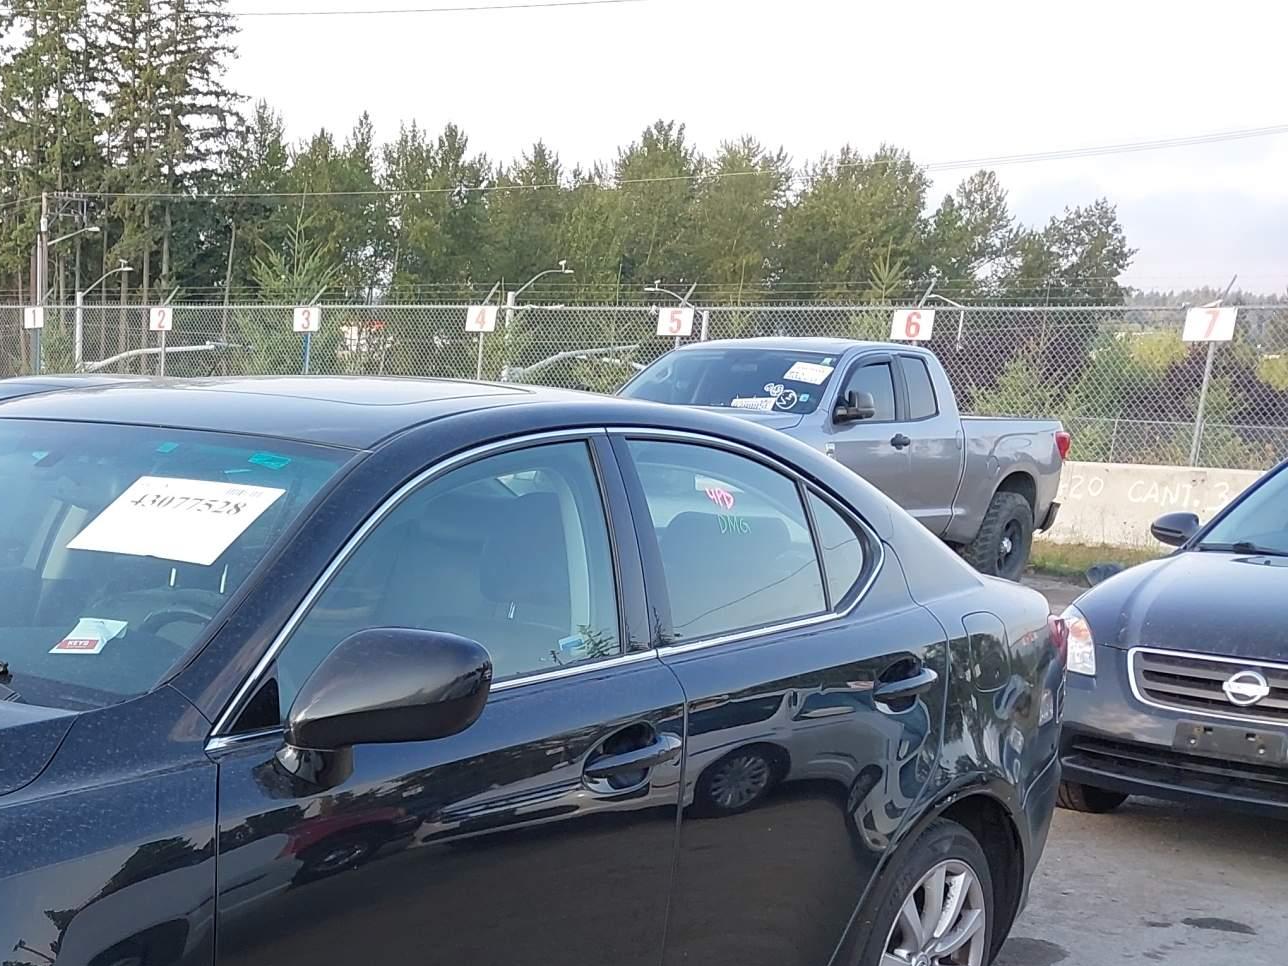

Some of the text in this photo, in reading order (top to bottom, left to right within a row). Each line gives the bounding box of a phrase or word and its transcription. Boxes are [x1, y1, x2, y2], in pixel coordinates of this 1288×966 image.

[158, 309, 166, 329] 2
[302, 309, 311, 330] 3
[475, 308, 486, 330] 4
[669, 309, 683, 333] 5
[905, 310, 921, 338] 6
[1204, 309, 1220, 339] 7
[131, 493, 248, 515] 43077528
